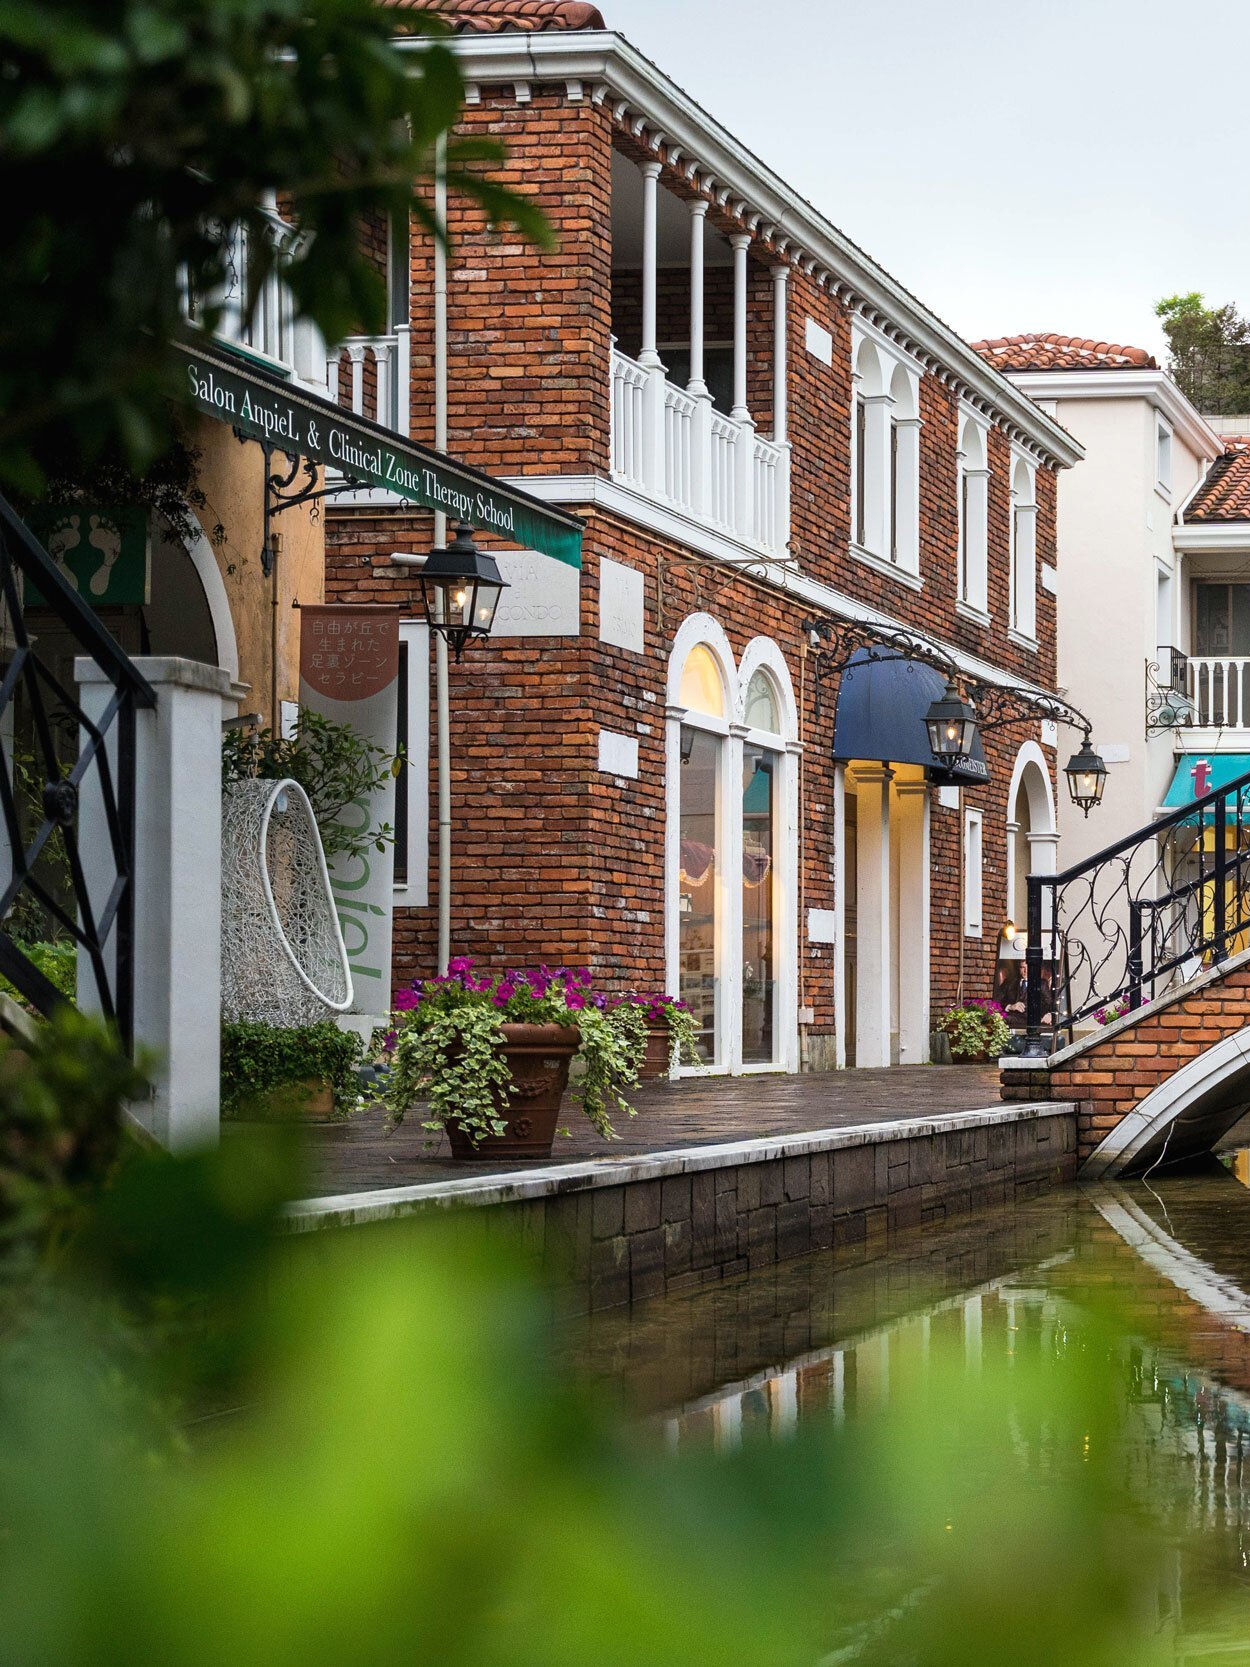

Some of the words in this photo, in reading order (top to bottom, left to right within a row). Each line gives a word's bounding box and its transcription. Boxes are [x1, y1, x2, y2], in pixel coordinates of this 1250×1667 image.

[188, 364, 236, 413] Salon
[241, 390, 299, 441] AnpieL
[307, 420, 321, 450] &
[329, 429, 382, 476] Clinical
[386, 453, 419, 491] Zone
[422, 469, 474, 521] Therapy
[477, 492, 514, 531] School
[313, 620, 390, 635] 自由が丘で
[319, 637, 380, 652] 生まれた
[309, 653, 388, 669] 足裏ゾーン
